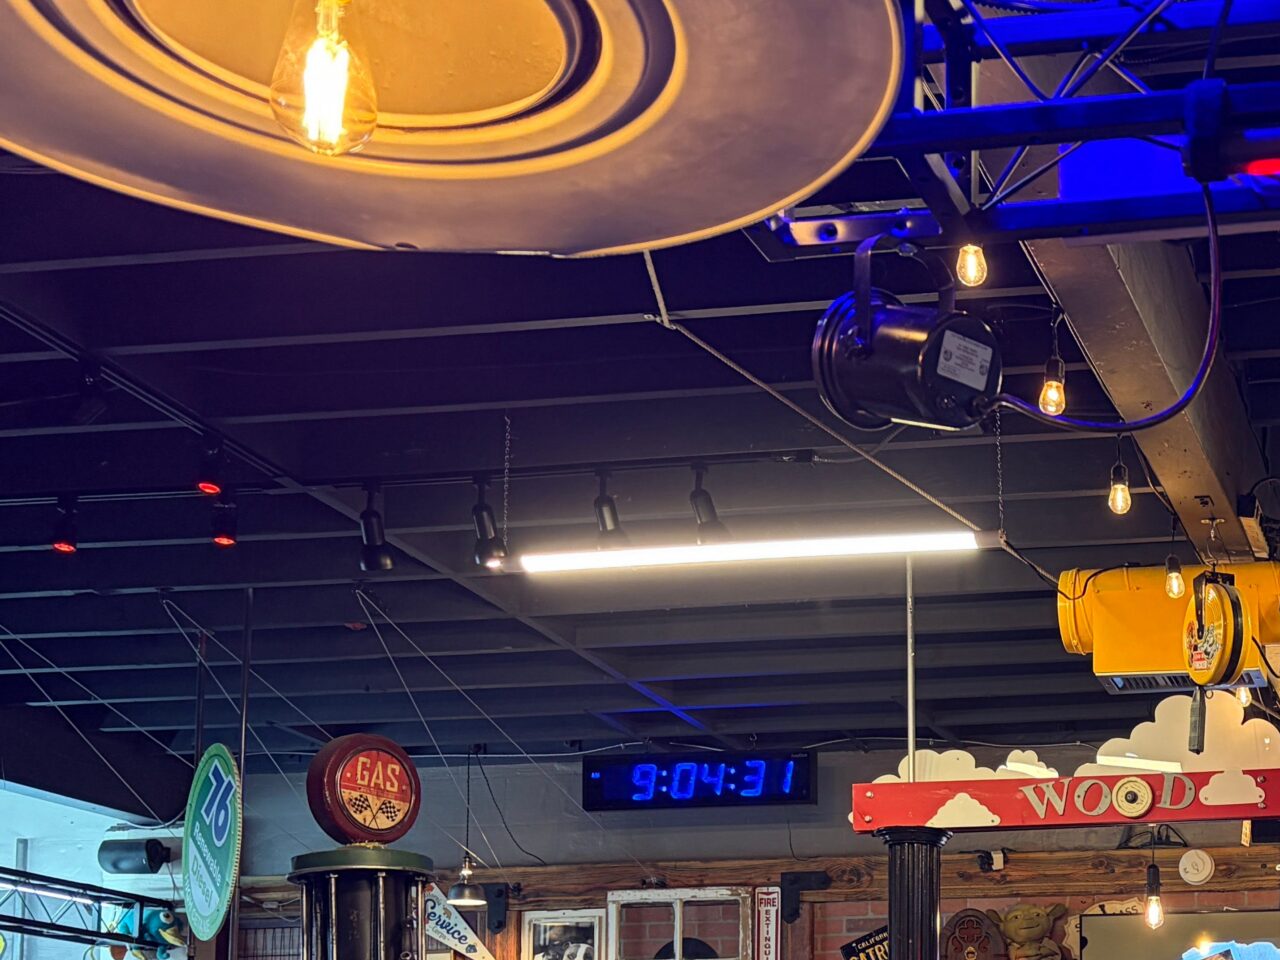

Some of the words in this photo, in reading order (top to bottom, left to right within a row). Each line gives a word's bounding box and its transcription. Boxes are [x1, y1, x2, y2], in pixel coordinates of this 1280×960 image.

[356, 756, 400, 792] GAS
[632, 760, 793, 800] 9:04:31
[1019, 772, 1195, 819] WOOD
[201, 759, 236, 847] 76
[193, 821, 222, 887] Renewable
[191, 853, 213, 907] Diesel
[759, 897, 777, 907] FIRE
[425, 898, 468, 944] Service
